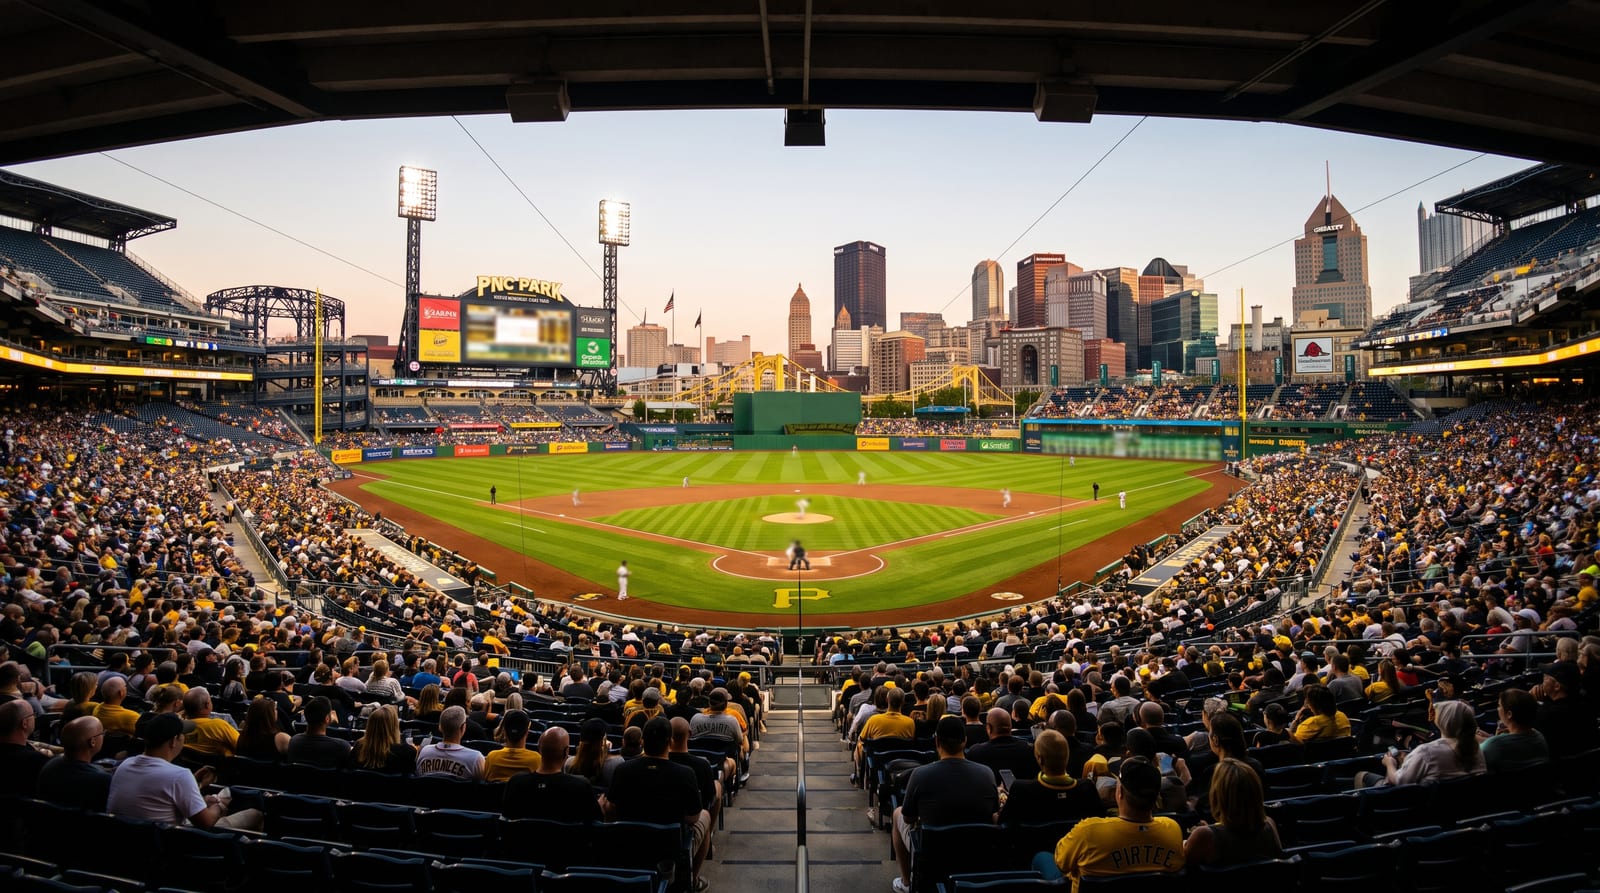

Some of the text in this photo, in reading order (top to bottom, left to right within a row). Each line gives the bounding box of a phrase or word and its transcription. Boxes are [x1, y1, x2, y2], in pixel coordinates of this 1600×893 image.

[477, 275, 515, 297] PNC
[519, 277, 564, 303] PARK
[1111, 845, 1176, 869] PIRTEE
